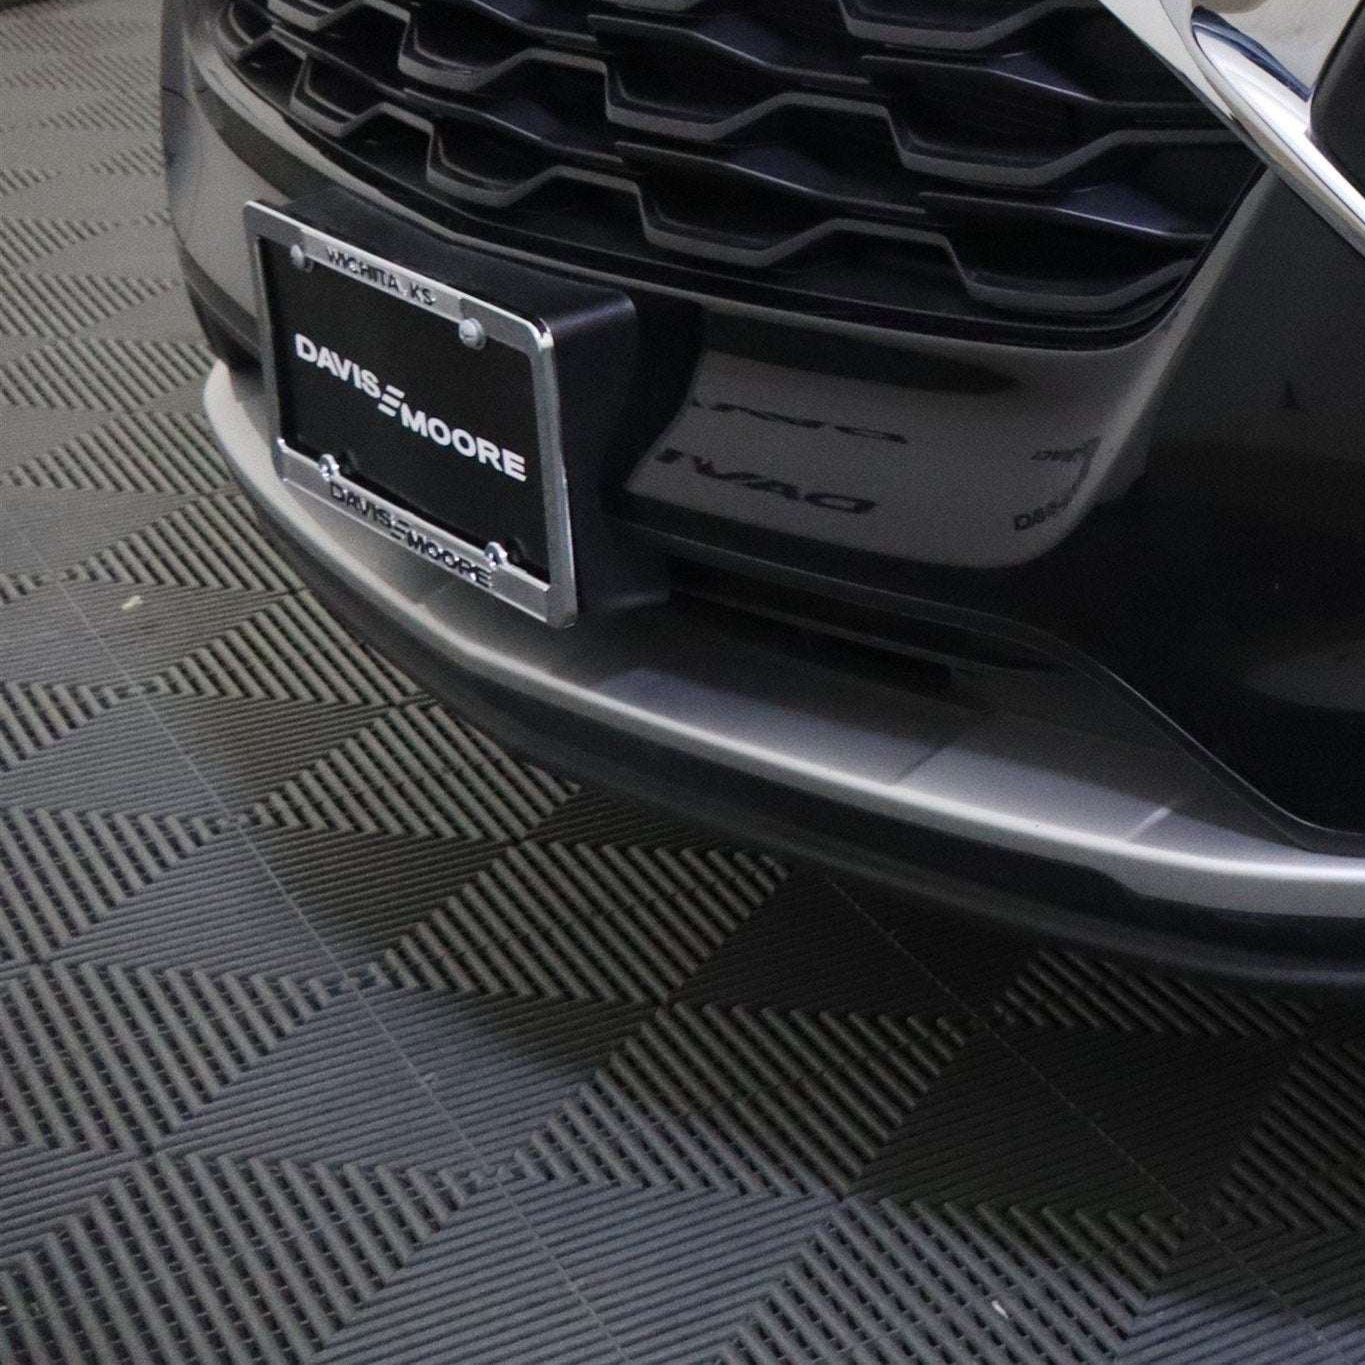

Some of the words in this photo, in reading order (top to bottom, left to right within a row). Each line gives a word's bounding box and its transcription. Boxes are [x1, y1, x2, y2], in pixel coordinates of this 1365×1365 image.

[408, 278, 438, 307] KS
[295, 333, 382, 400] DAVIS
[401, 402, 528, 483] MOORE
[329, 482, 393, 530] DAVIS
[406, 528, 493, 588] MOORE
